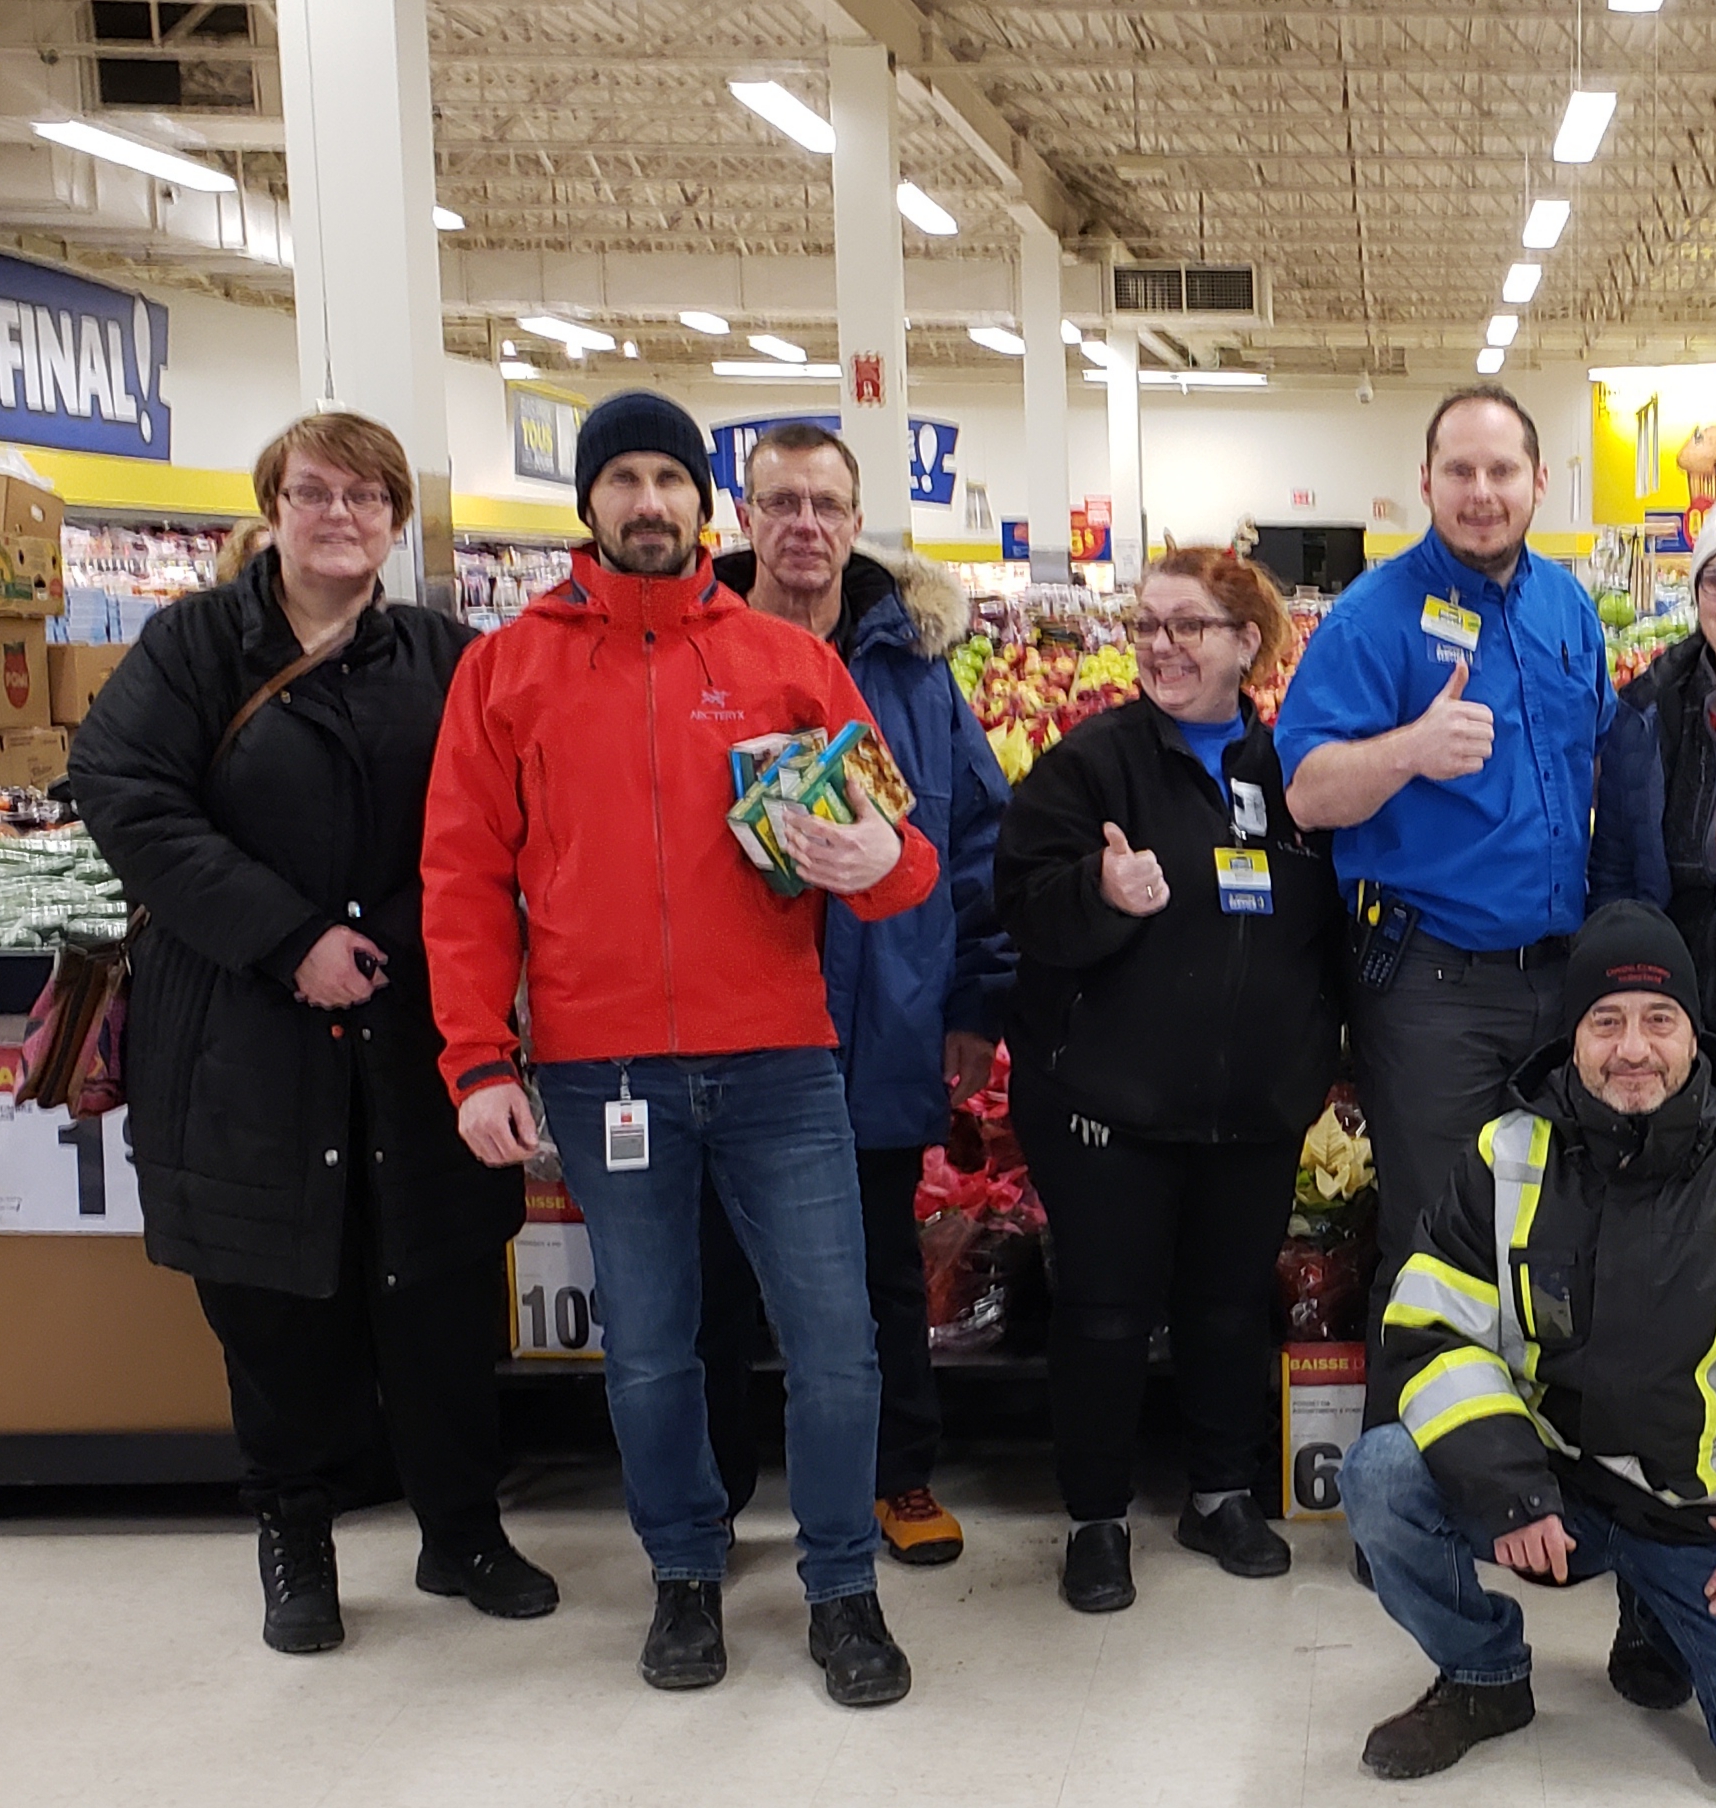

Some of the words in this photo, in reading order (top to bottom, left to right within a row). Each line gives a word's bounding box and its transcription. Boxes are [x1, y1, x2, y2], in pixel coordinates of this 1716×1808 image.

[0, 296, 153, 444] FINAL!
[526, 1197, 565, 1209] AISSE
[1290, 1358, 1348, 1370] BAISSE
